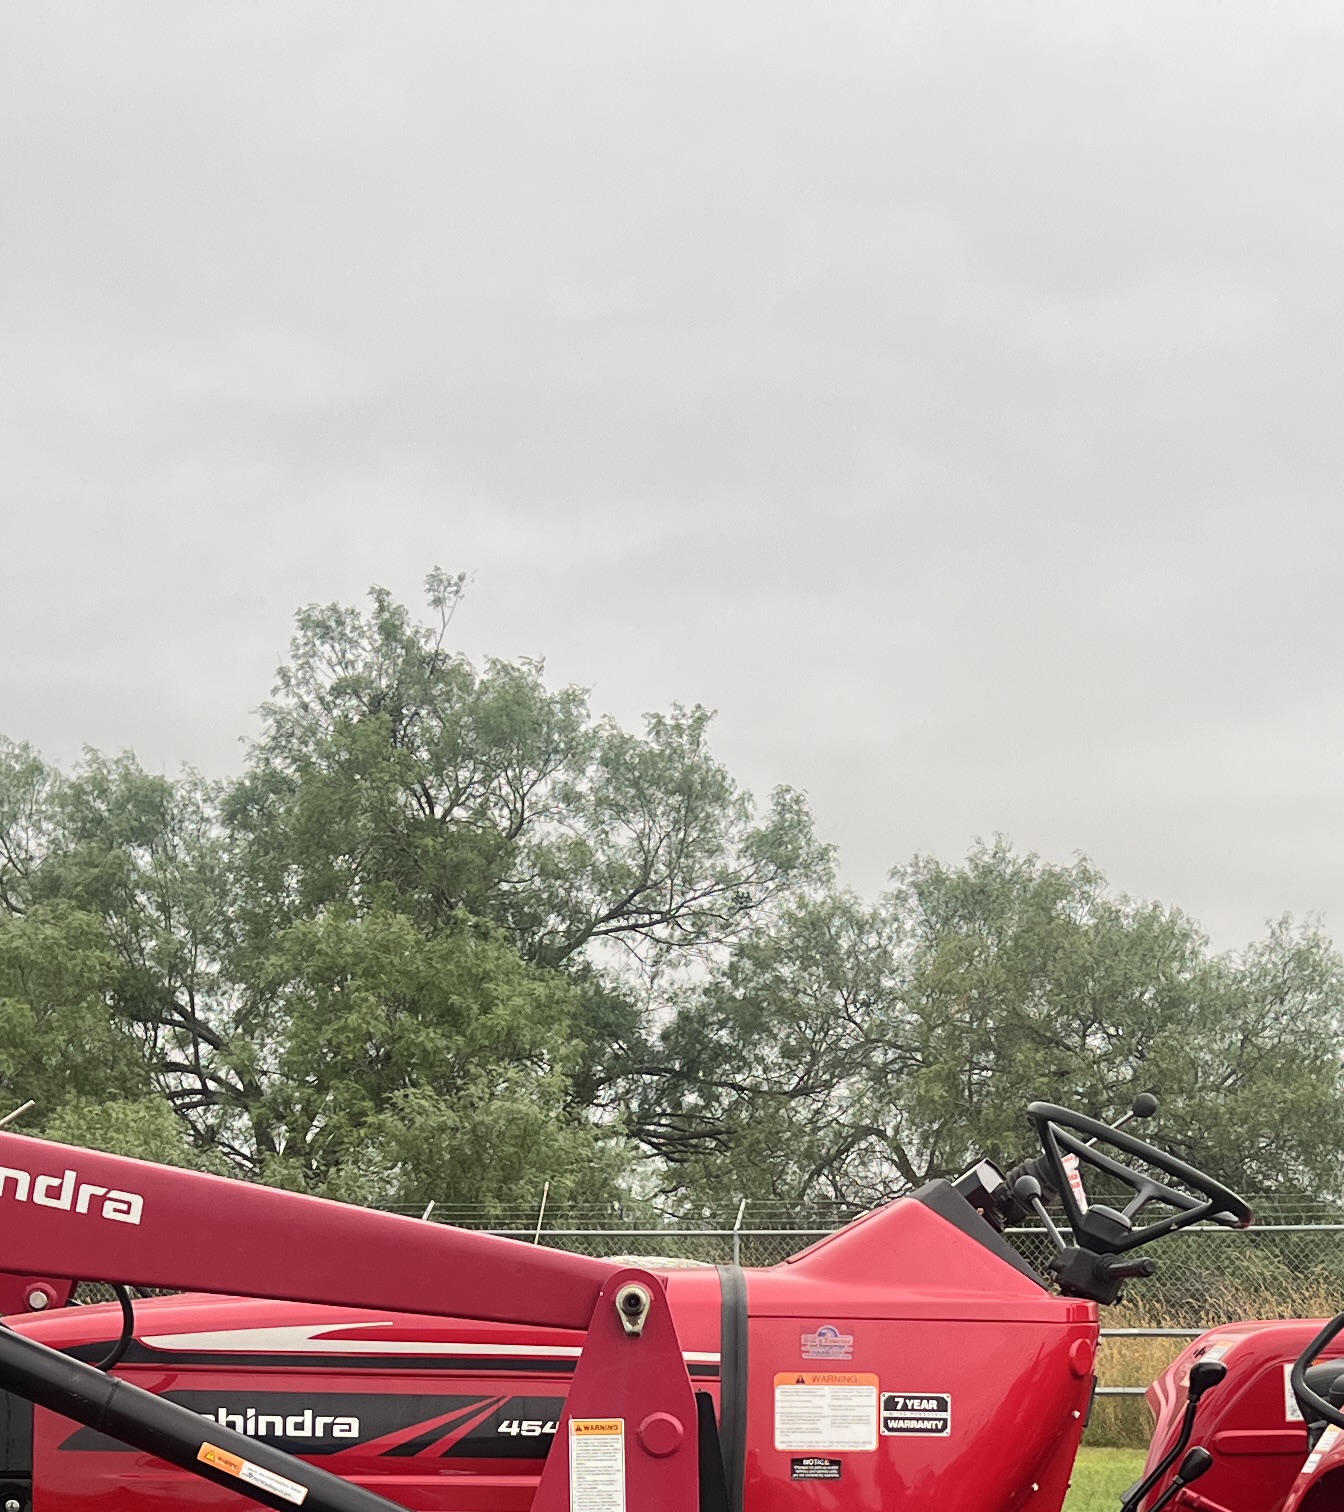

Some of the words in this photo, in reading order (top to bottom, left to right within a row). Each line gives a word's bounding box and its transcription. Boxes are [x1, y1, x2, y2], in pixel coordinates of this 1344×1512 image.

[812, 1374, 858, 1383] WARNING
[894, 1397, 905, 1410] 7
[905, 1399, 938, 1410] YEAR
[199, 1406, 359, 1438] hindra
[887, 1419, 944, 1430] WARRANTY
[583, 1424, 619, 1432] WARNING
